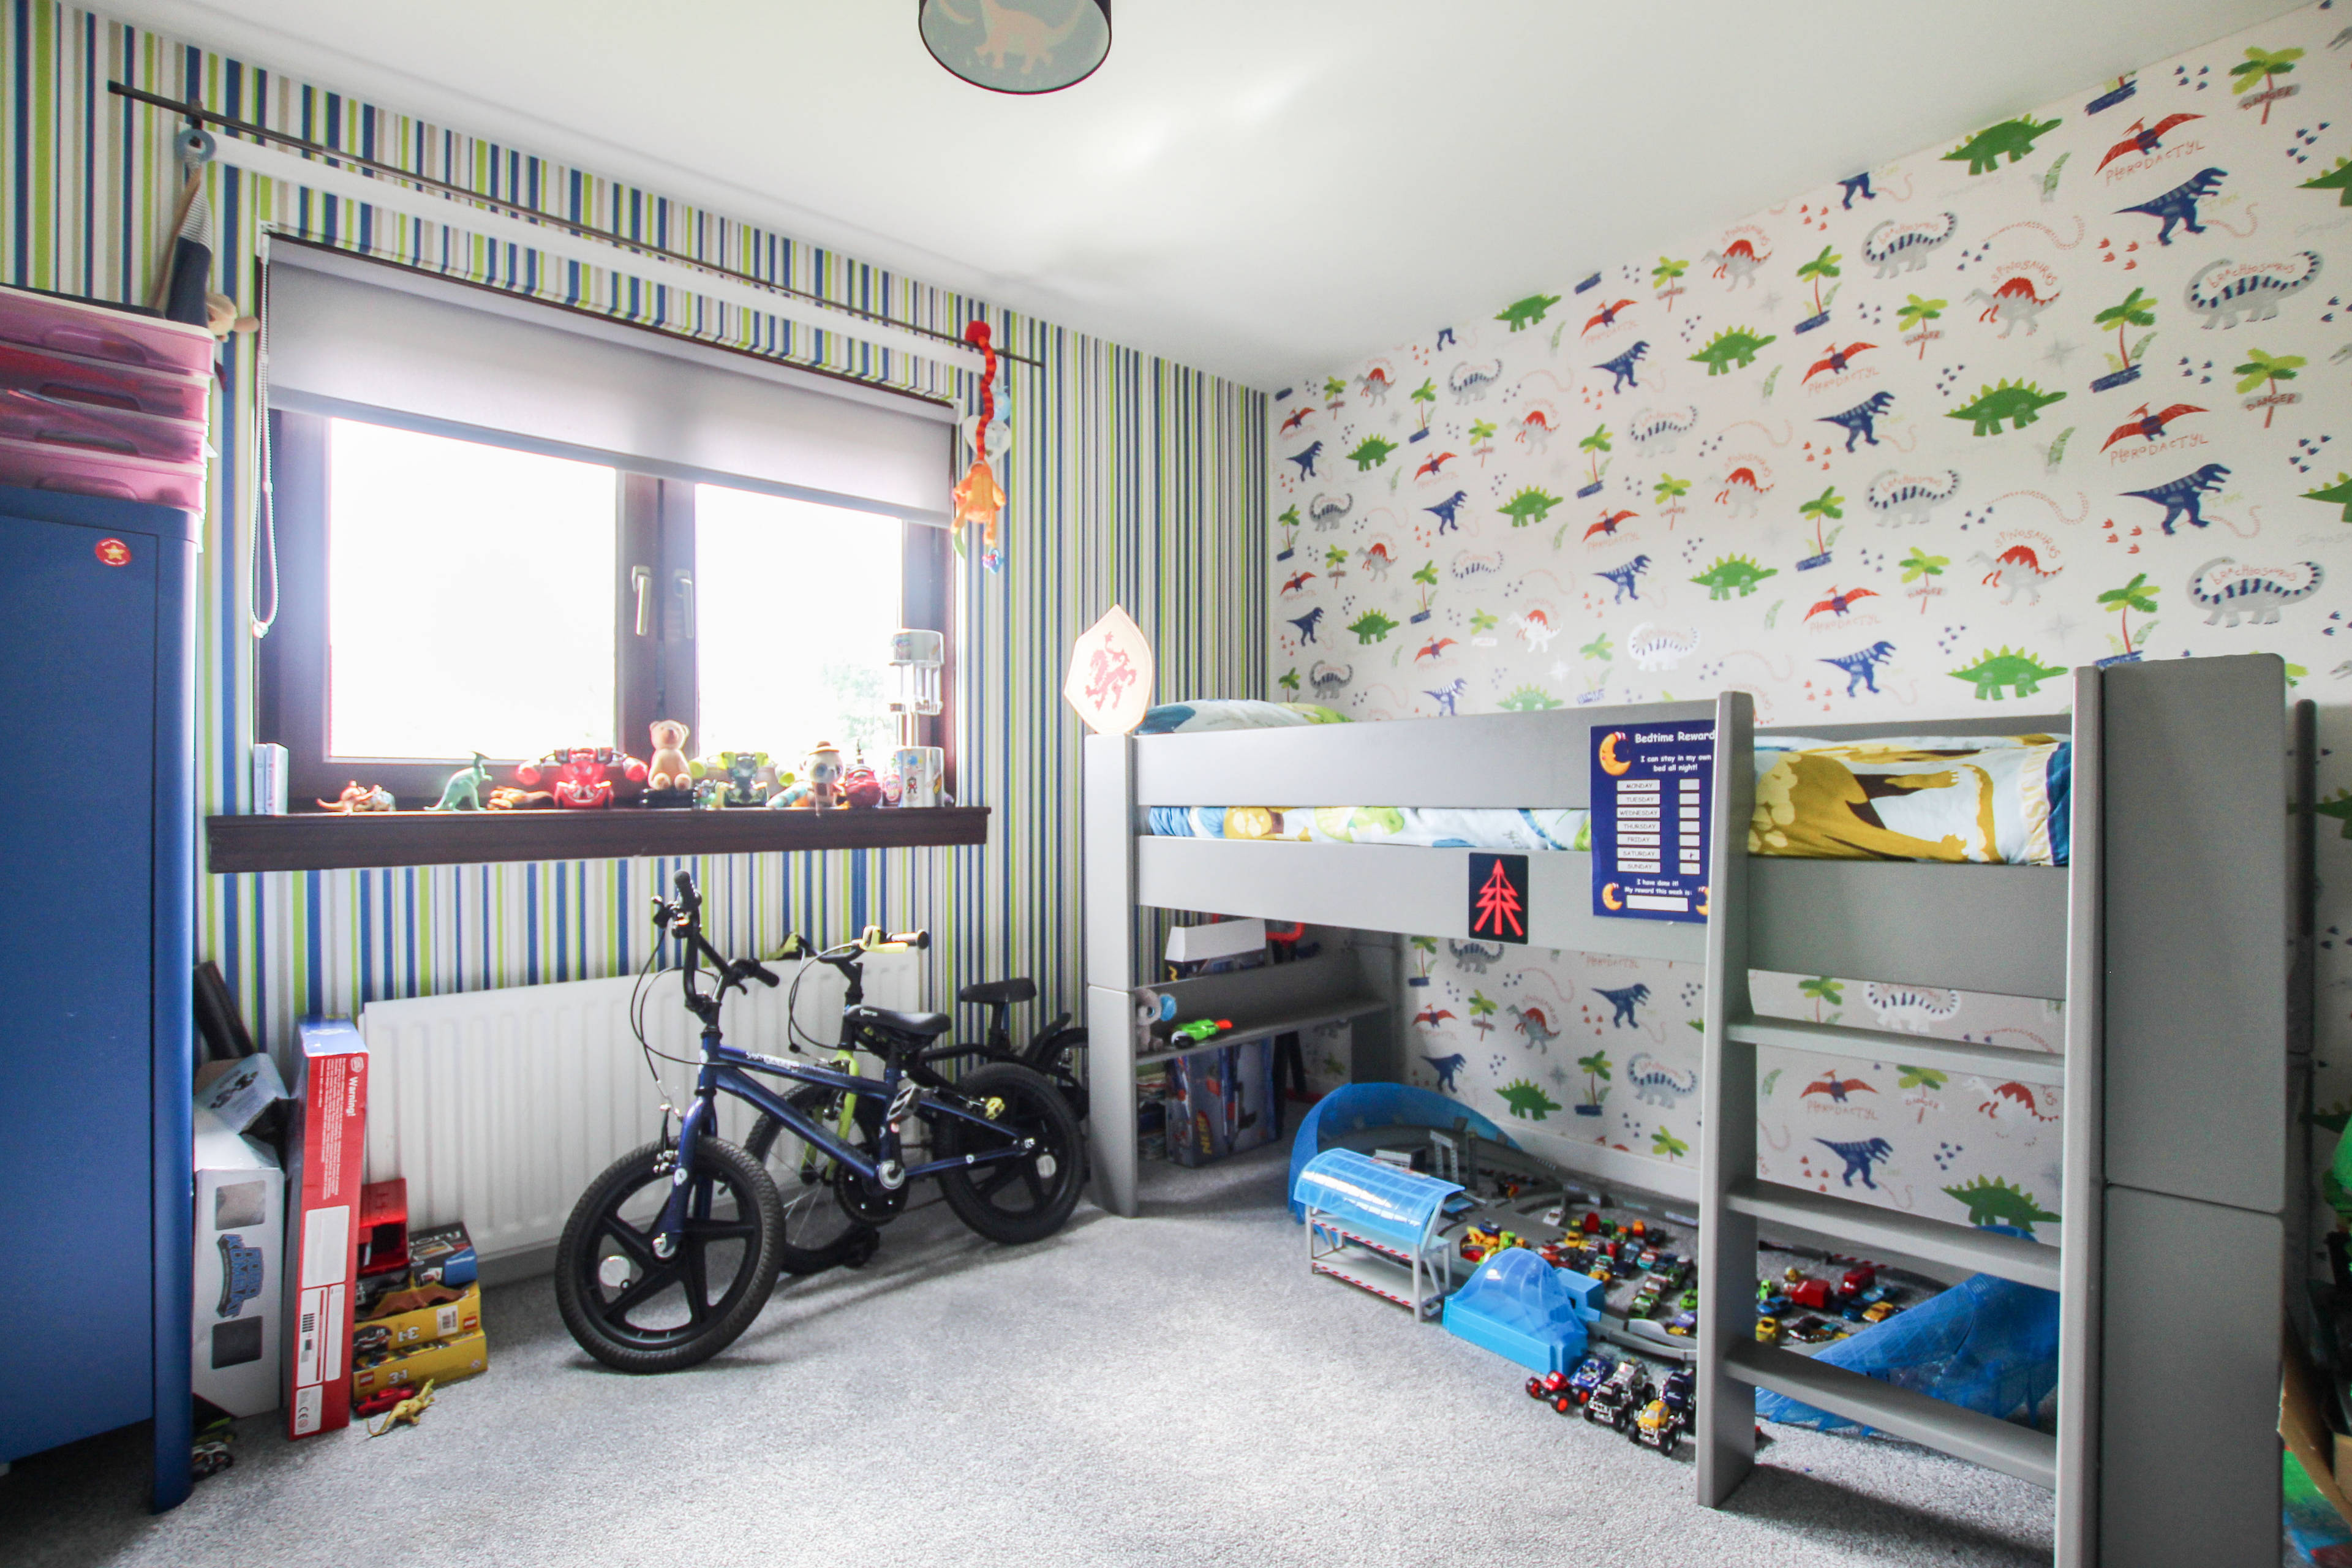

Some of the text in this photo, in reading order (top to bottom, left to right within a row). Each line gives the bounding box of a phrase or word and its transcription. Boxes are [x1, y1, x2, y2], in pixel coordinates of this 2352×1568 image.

[1635, 729, 1715, 744] Bedtime Reward
[1678, 764, 1698, 773] night!
[346, 1076, 358, 1117] Warning!
